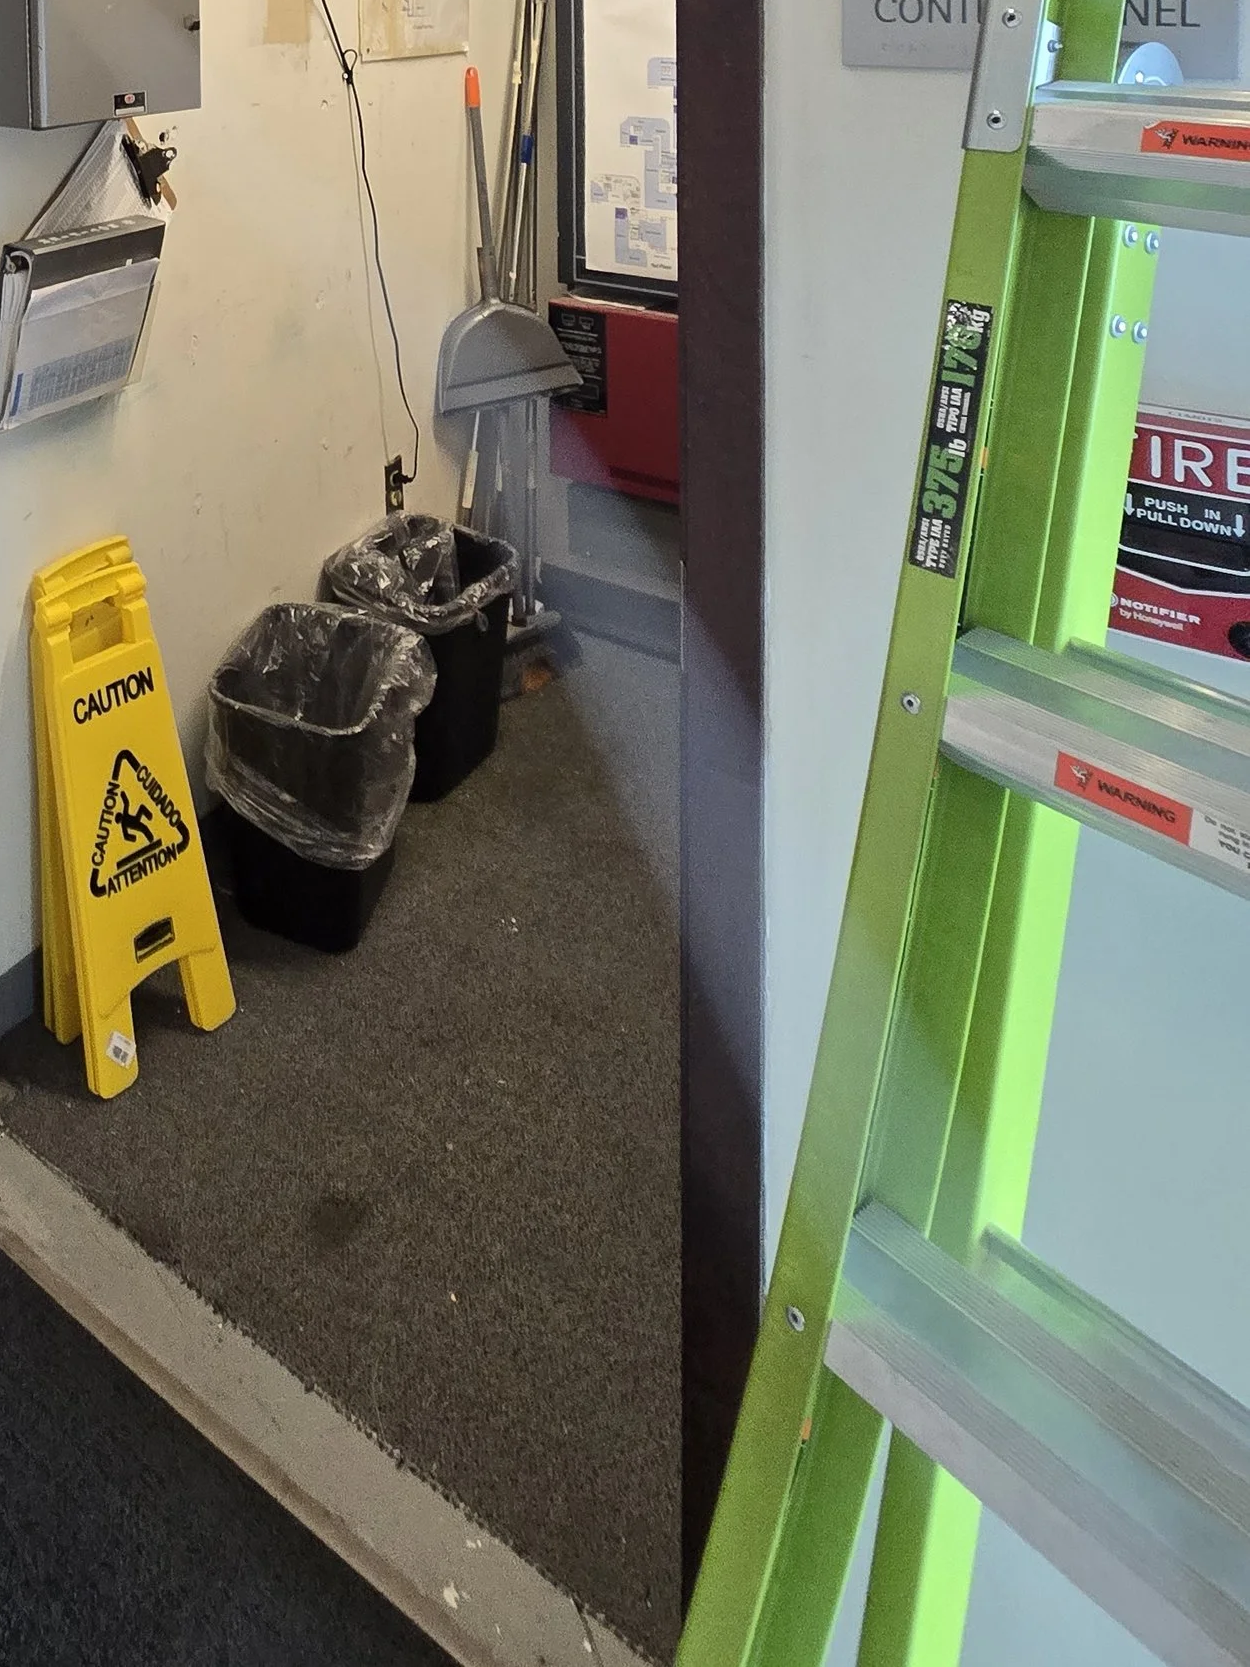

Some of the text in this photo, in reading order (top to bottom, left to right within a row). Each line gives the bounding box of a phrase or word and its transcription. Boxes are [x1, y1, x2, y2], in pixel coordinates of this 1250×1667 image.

[1182, 134, 1250, 151] WARNIN
[945, 407, 960, 433] TIPO
[1134, 432, 1250, 495] IRE
[1136, 508, 1232, 537] PULL DOWN
[1144, 496, 1221, 521] PUSH IN
[925, 538, 940, 568] TYPE
[1119, 607, 1184, 631] by Honeywell
[1120, 597, 1201, 625] NOTIFIER
[73, 667, 155, 725] CAUTION
[136, 765, 182, 828] CUIDADO
[1097, 779, 1176, 824] WARNING
[92, 781, 121, 868] CAUTION
[106, 842, 178, 898] ATTENTION
